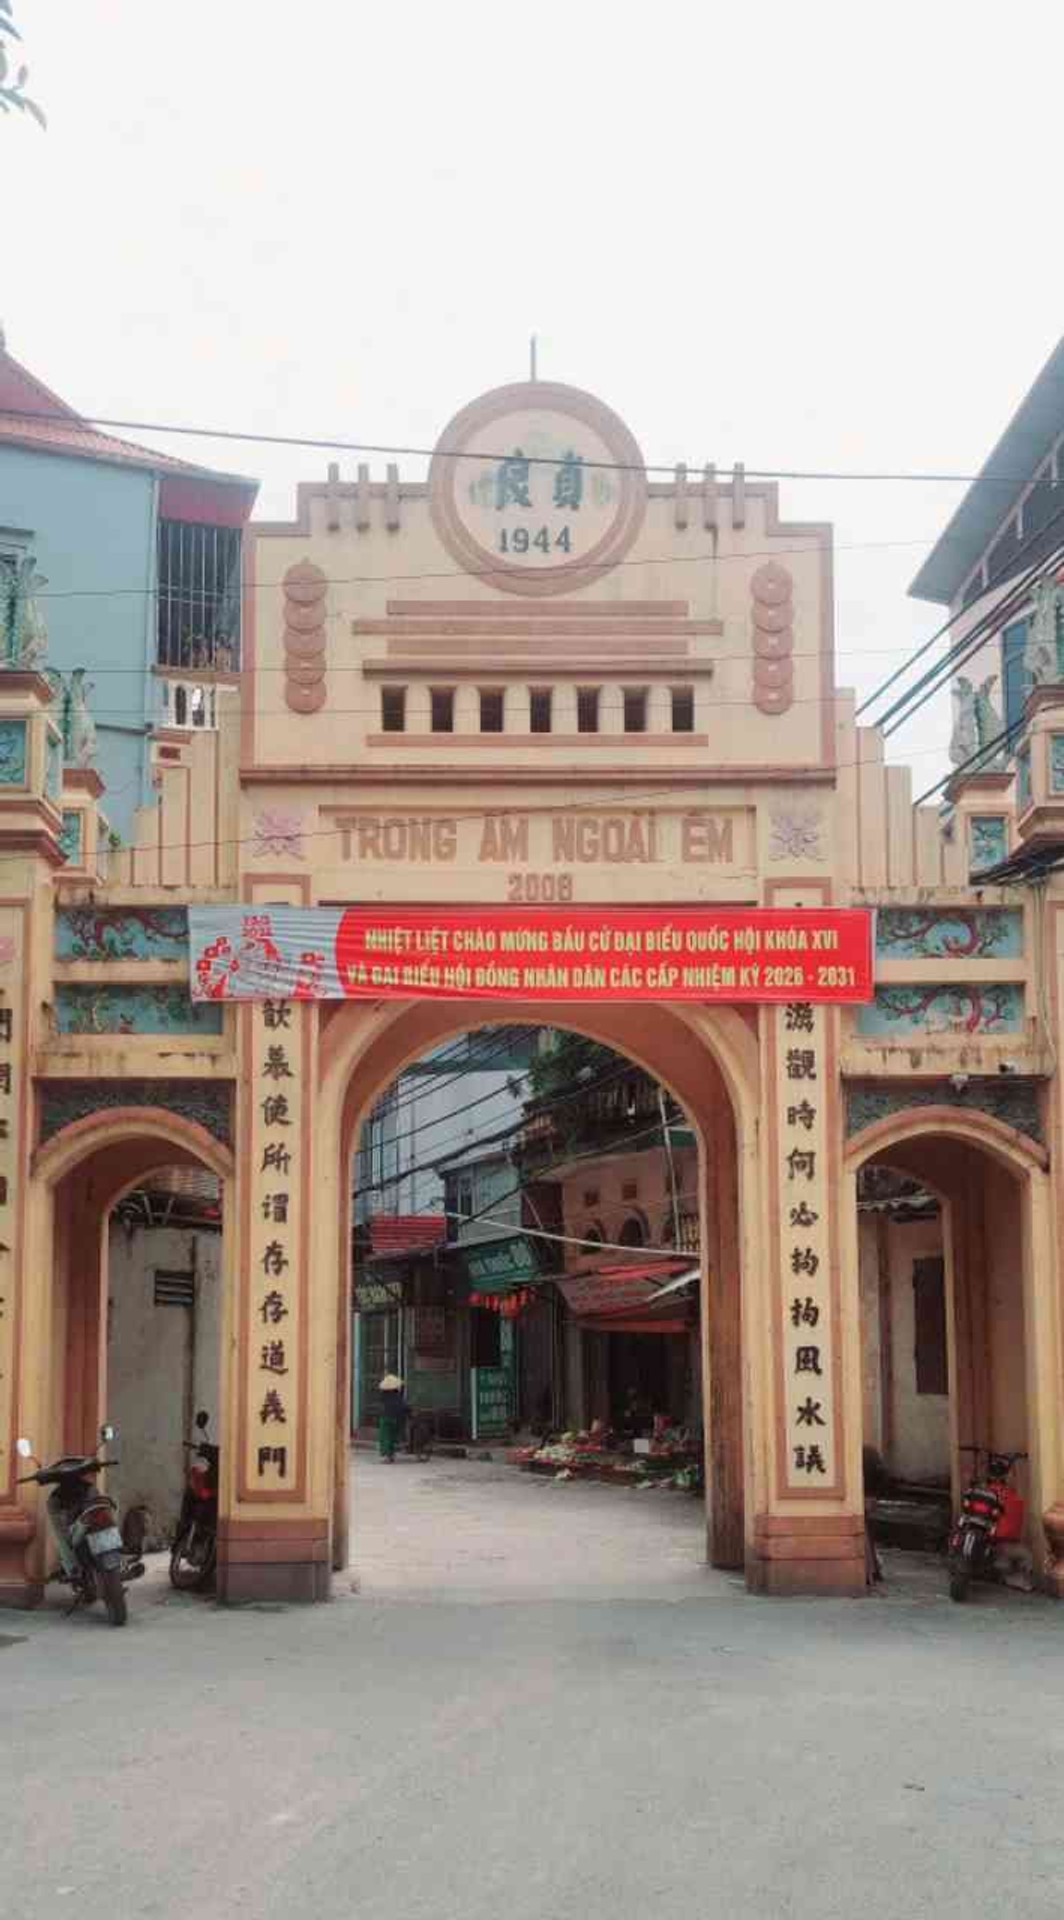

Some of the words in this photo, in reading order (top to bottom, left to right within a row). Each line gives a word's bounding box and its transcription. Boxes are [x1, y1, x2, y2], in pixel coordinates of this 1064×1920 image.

[500, 526, 572, 553] 1944
[335, 817, 457, 861] TRONG
[507, 873, 573, 901] 2008
[365, 926, 410, 955] NHIỆT
[416, 926, 448, 955] LIỆT
[453, 926, 495, 951] CHÀO
[500, 926, 548, 951] MỪNG
[686, 924, 731, 952] QUỐC
[734, 926, 760, 955] HỘI
[812, 929, 838, 950] XVI
[347, 961, 367, 984] VÀ
[444, 963, 471, 991] HỘI
[523, 963, 569, 987] NHÂN
[573, 964, 606, 987] DÂN
[610, 964, 642, 987] CÁC
[646, 961, 679, 987] CẤP
[683, 963, 735, 991] NHIỆM
[764, 966, 804, 987] 2026
[817, 966, 856, 987] 2031
